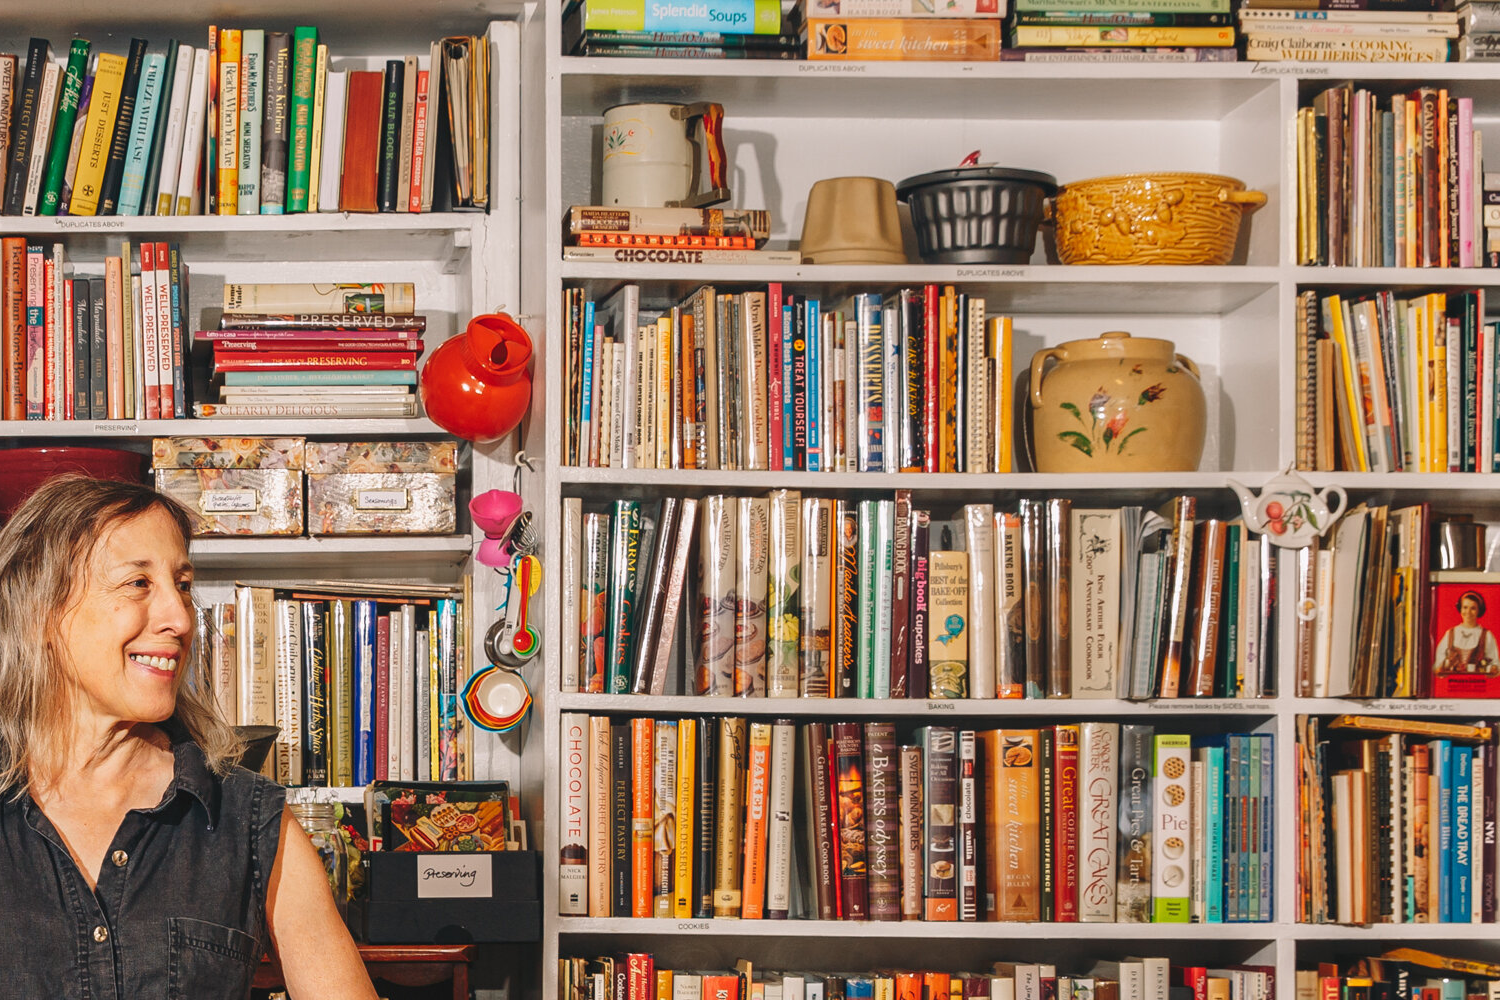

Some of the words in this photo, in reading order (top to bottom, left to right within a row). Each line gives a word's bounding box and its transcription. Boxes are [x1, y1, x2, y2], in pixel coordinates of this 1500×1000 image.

[653, 3, 707, 19] Splendid
[709, 10, 747, 26] Soups
[2, 61, 12, 91] SWEET
[224, 65, 236, 95] Ready
[21, 89, 34, 127] PERFECT
[100, 91, 112, 115] JUST
[224, 98, 236, 127] When
[387, 92, 397, 119] SALT
[15, 130, 28, 163] PASTRY
[90, 120, 106, 168] DESSERTS
[224, 129, 235, 146] You
[386, 123, 395, 160] BLOCK
[224, 150, 234, 167] Are
[615, 249, 703, 263] CHOCOLATE
[159, 284, 170, 371] WELL-PRESERVED
[300, 315, 395, 328] PRESERVED
[795, 356, 804, 388] TREAT
[795, 392, 805, 447] YOURSELF!
[616, 600, 631, 665] Cookies
[914, 614, 926, 664] cupcakes
[874, 744, 883, 753] a
[568, 726, 582, 838] CHOCOLATE
[752, 751, 766, 819] BAKED
[817, 757, 827, 801] GREYSTON
[873, 756, 888, 816] BAKER'S
[1457, 785, 1467, 803] THE
[820, 805, 829, 838] BAKERY
[1457, 806, 1468, 840] BREAD
[821, 842, 830, 885] COOKBOOK
[871, 819, 890, 879] odyssey
[1457, 841, 1467, 865] TRAY
[423, 865, 476, 887] Preserving
